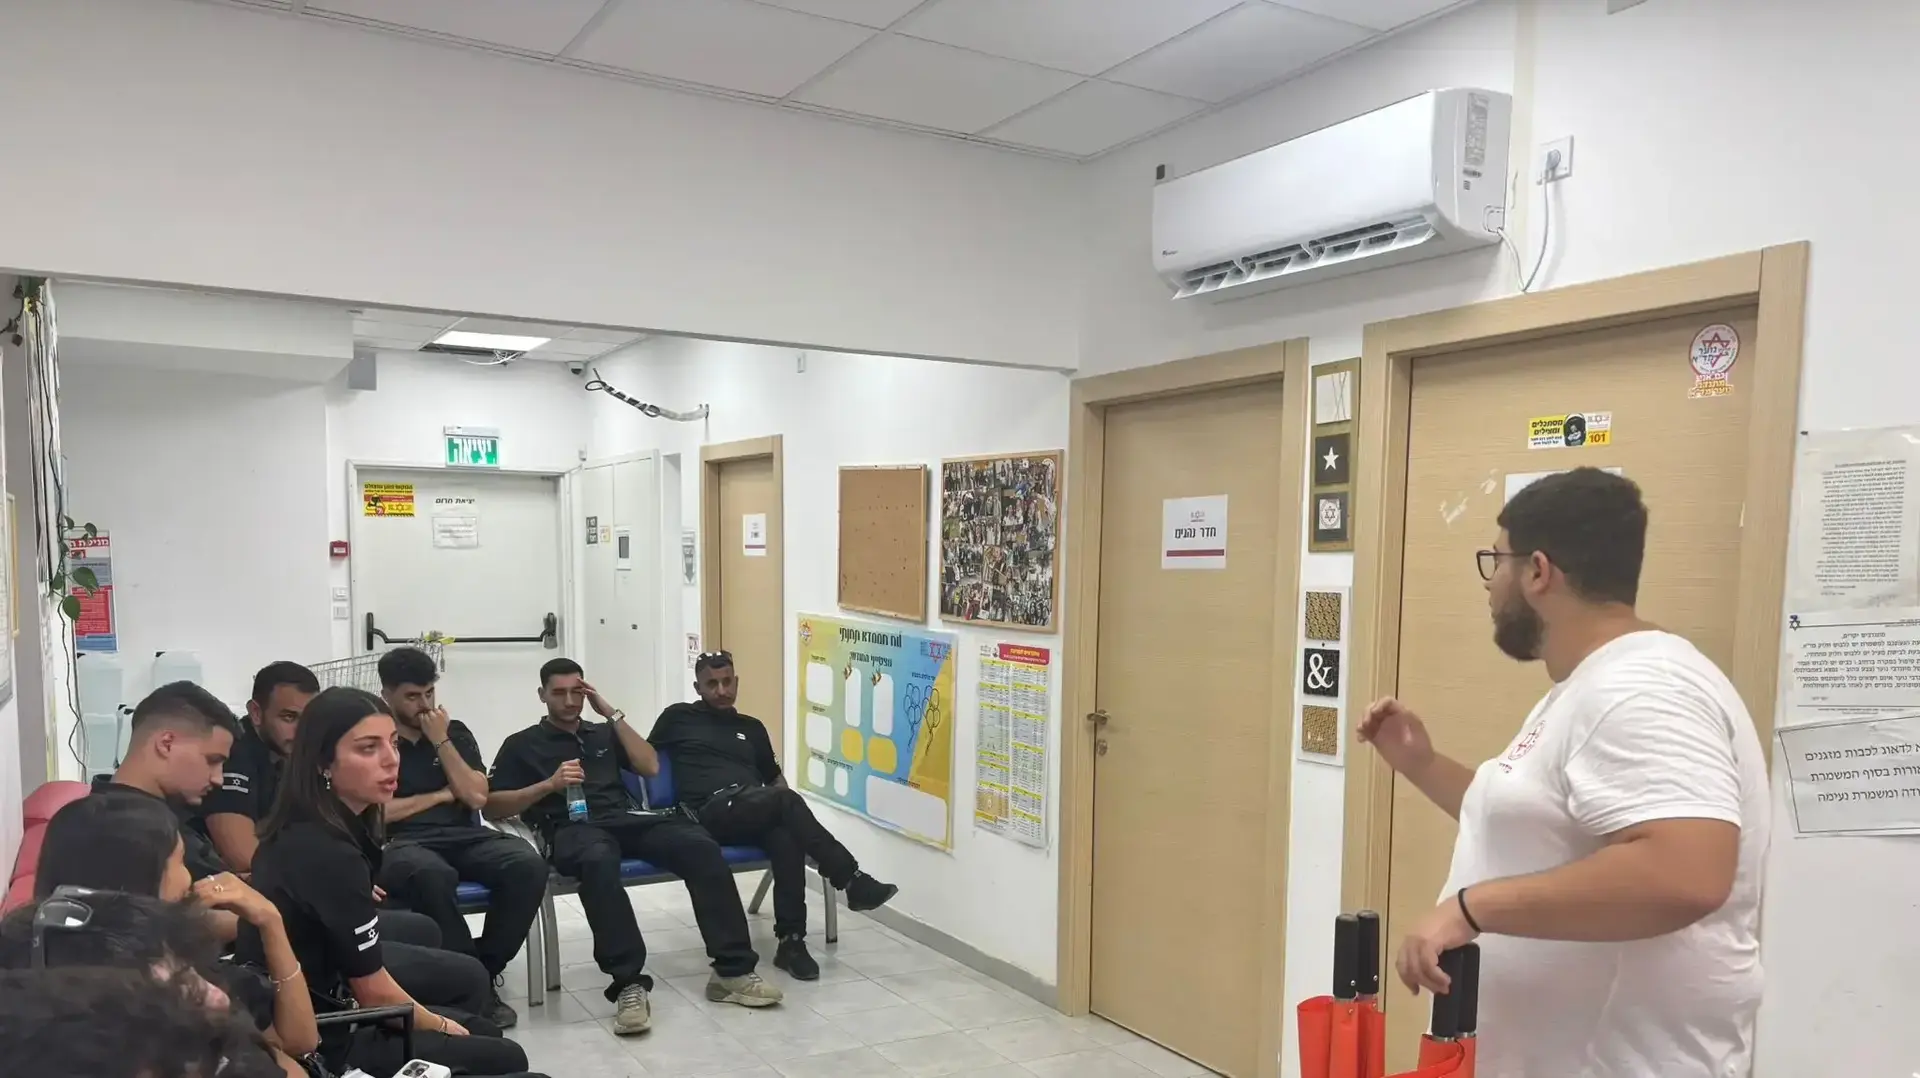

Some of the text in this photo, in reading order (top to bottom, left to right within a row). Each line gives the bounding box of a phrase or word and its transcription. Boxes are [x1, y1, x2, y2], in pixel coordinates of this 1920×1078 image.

[1531, 419, 1564, 428] מסתכלים
[1534, 427, 1561, 436] ומצילים
[1589, 433, 1606, 443] 101
[453, 438, 492, 464] יציאה
[1174, 526, 1217, 539] חדר נהגים
[890, 630, 902, 648] לוח
[1306, 653, 1334, 690] &
[1804, 750, 1841, 761] מזגנים
[1844, 745, 1878, 758] לכבות
[1881, 743, 1912, 755] לדאוג
[1810, 770, 1859, 782] המשמרת
[1862, 767, 1890, 780] בסוף
[1817, 787, 1920, 802] ודה ומשמרת נעימה
